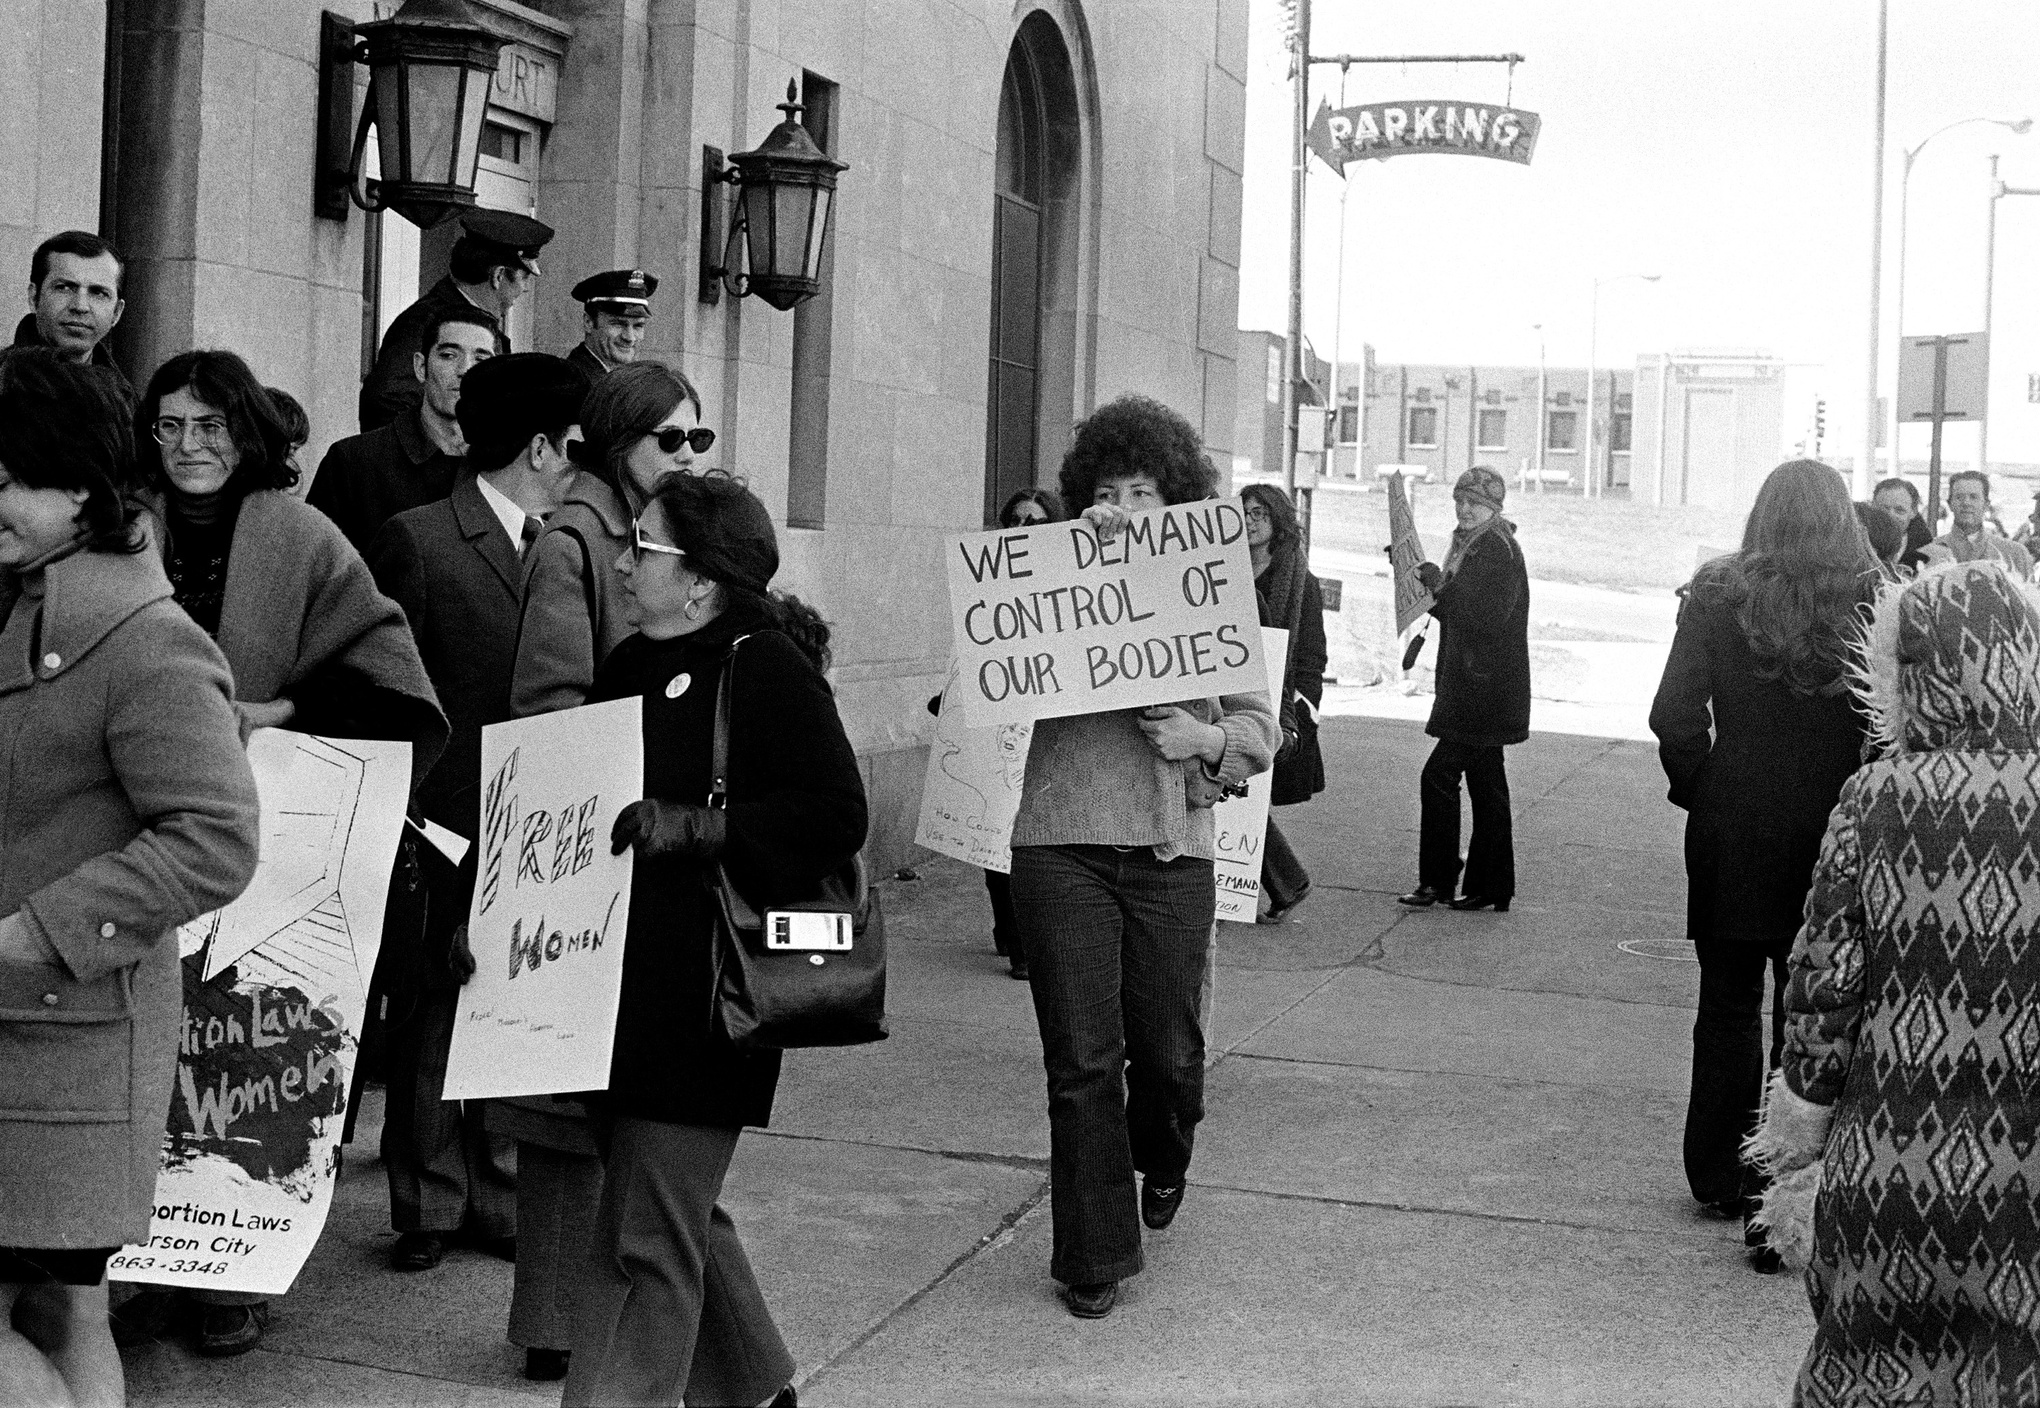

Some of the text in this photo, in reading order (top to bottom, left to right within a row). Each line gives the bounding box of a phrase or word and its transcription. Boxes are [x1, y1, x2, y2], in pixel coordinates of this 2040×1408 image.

[1327, 105, 1520, 150] PARKING
[959, 504, 1244, 583] WE DEMAND
[964, 559, 1228, 646] CONTROL OF
[978, 624, 1250, 702] OUR BODIES
[479, 746, 599, 917] FREE
[1215, 873, 1259, 891] EMAND
[178, 1050, 343, 1141] Women
[137, 1234, 257, 1257] rson City
[231, 1208, 293, 1232] Laws
